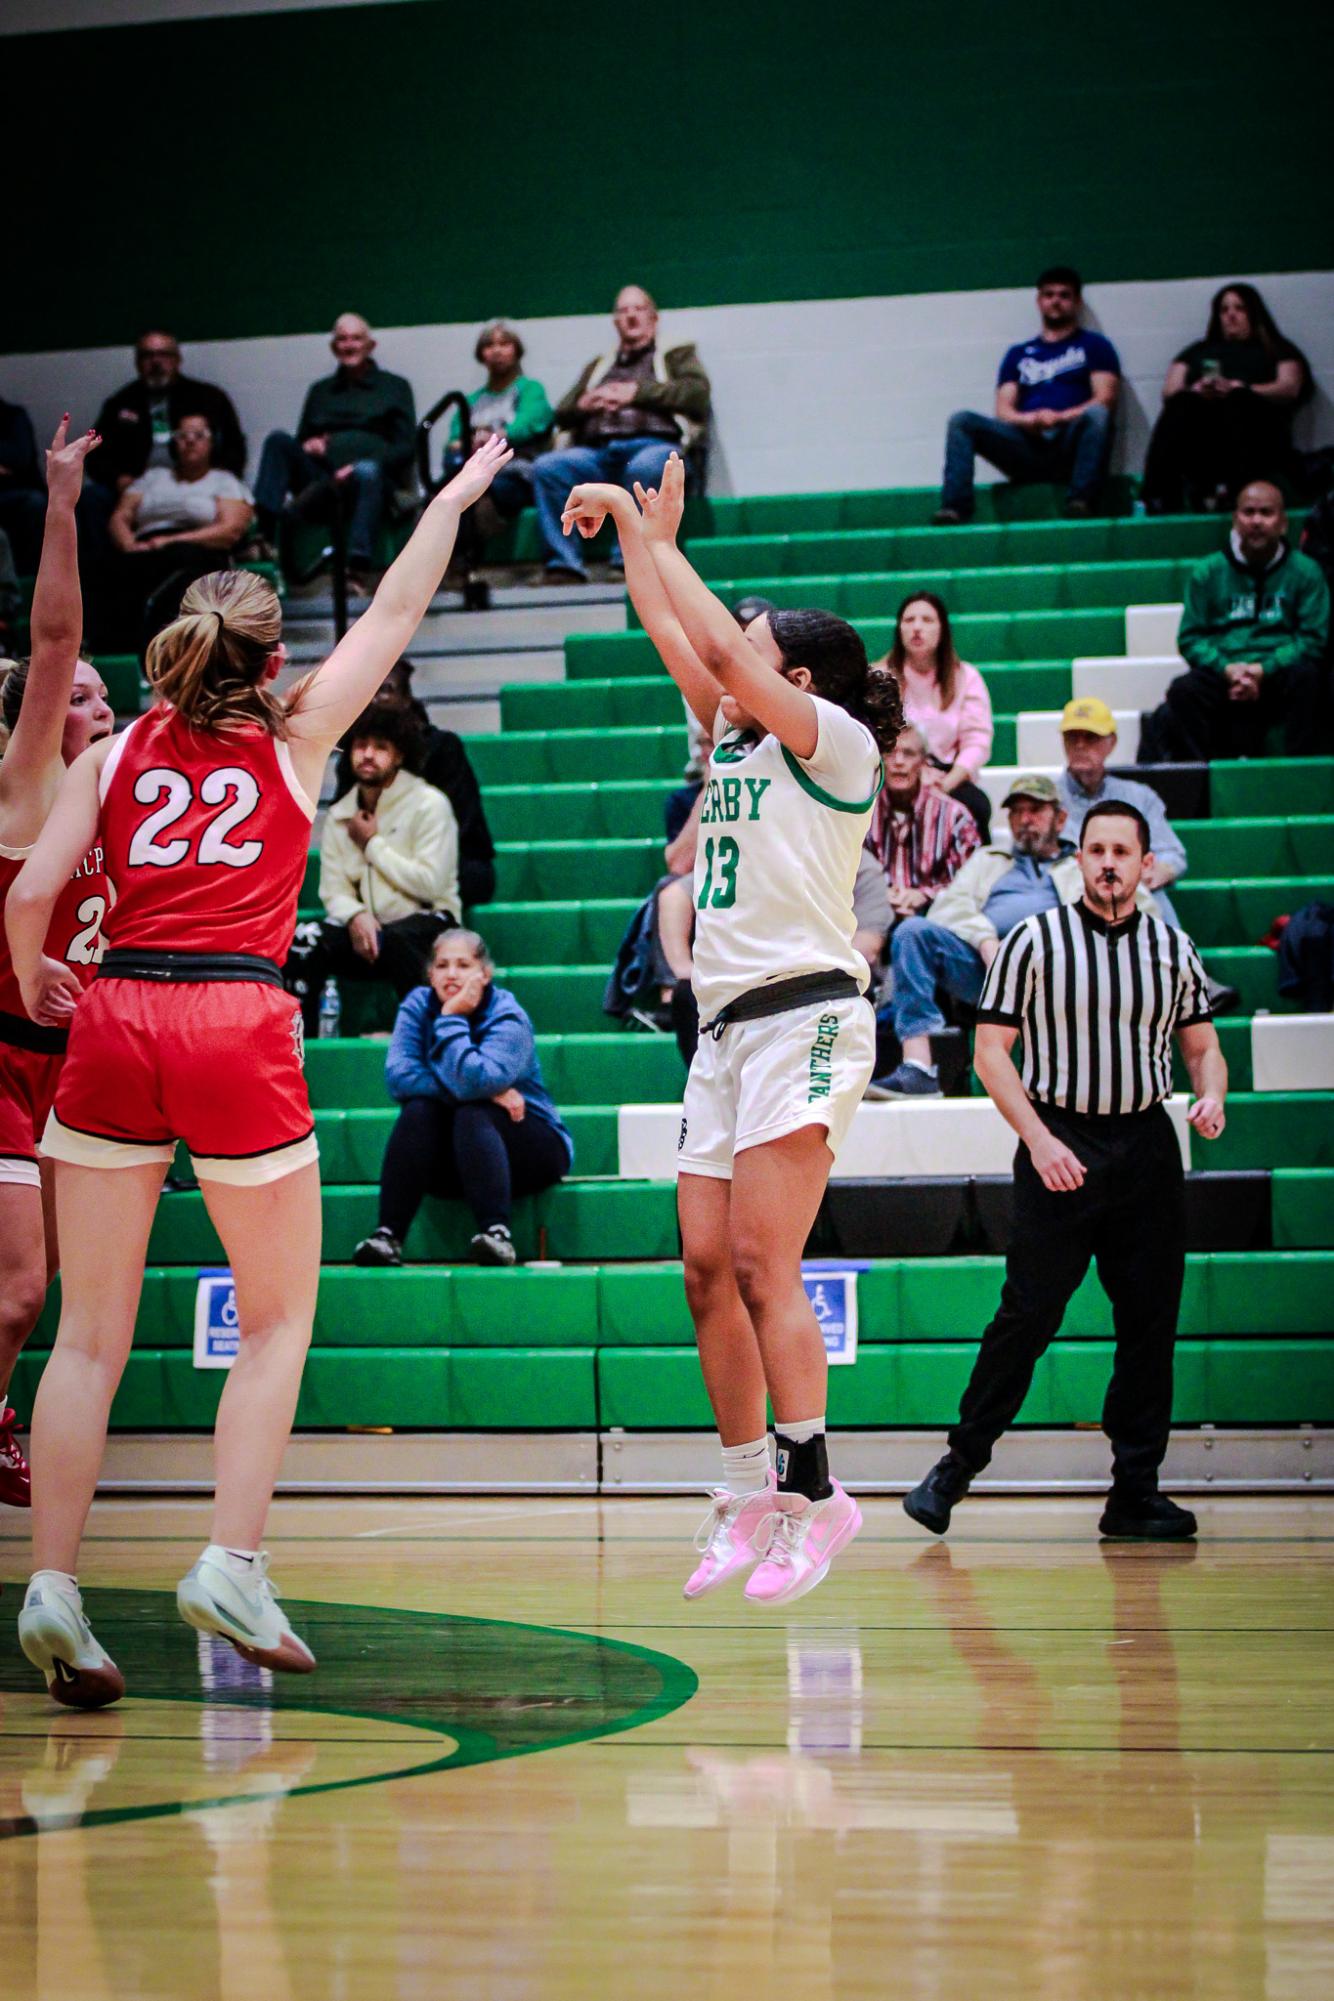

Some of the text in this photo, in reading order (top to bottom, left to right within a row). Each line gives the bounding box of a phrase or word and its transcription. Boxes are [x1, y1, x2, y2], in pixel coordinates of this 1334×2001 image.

[128, 766, 265, 868] 22
[701, 777, 772, 824] ERBY
[697, 836, 740, 910] 13
